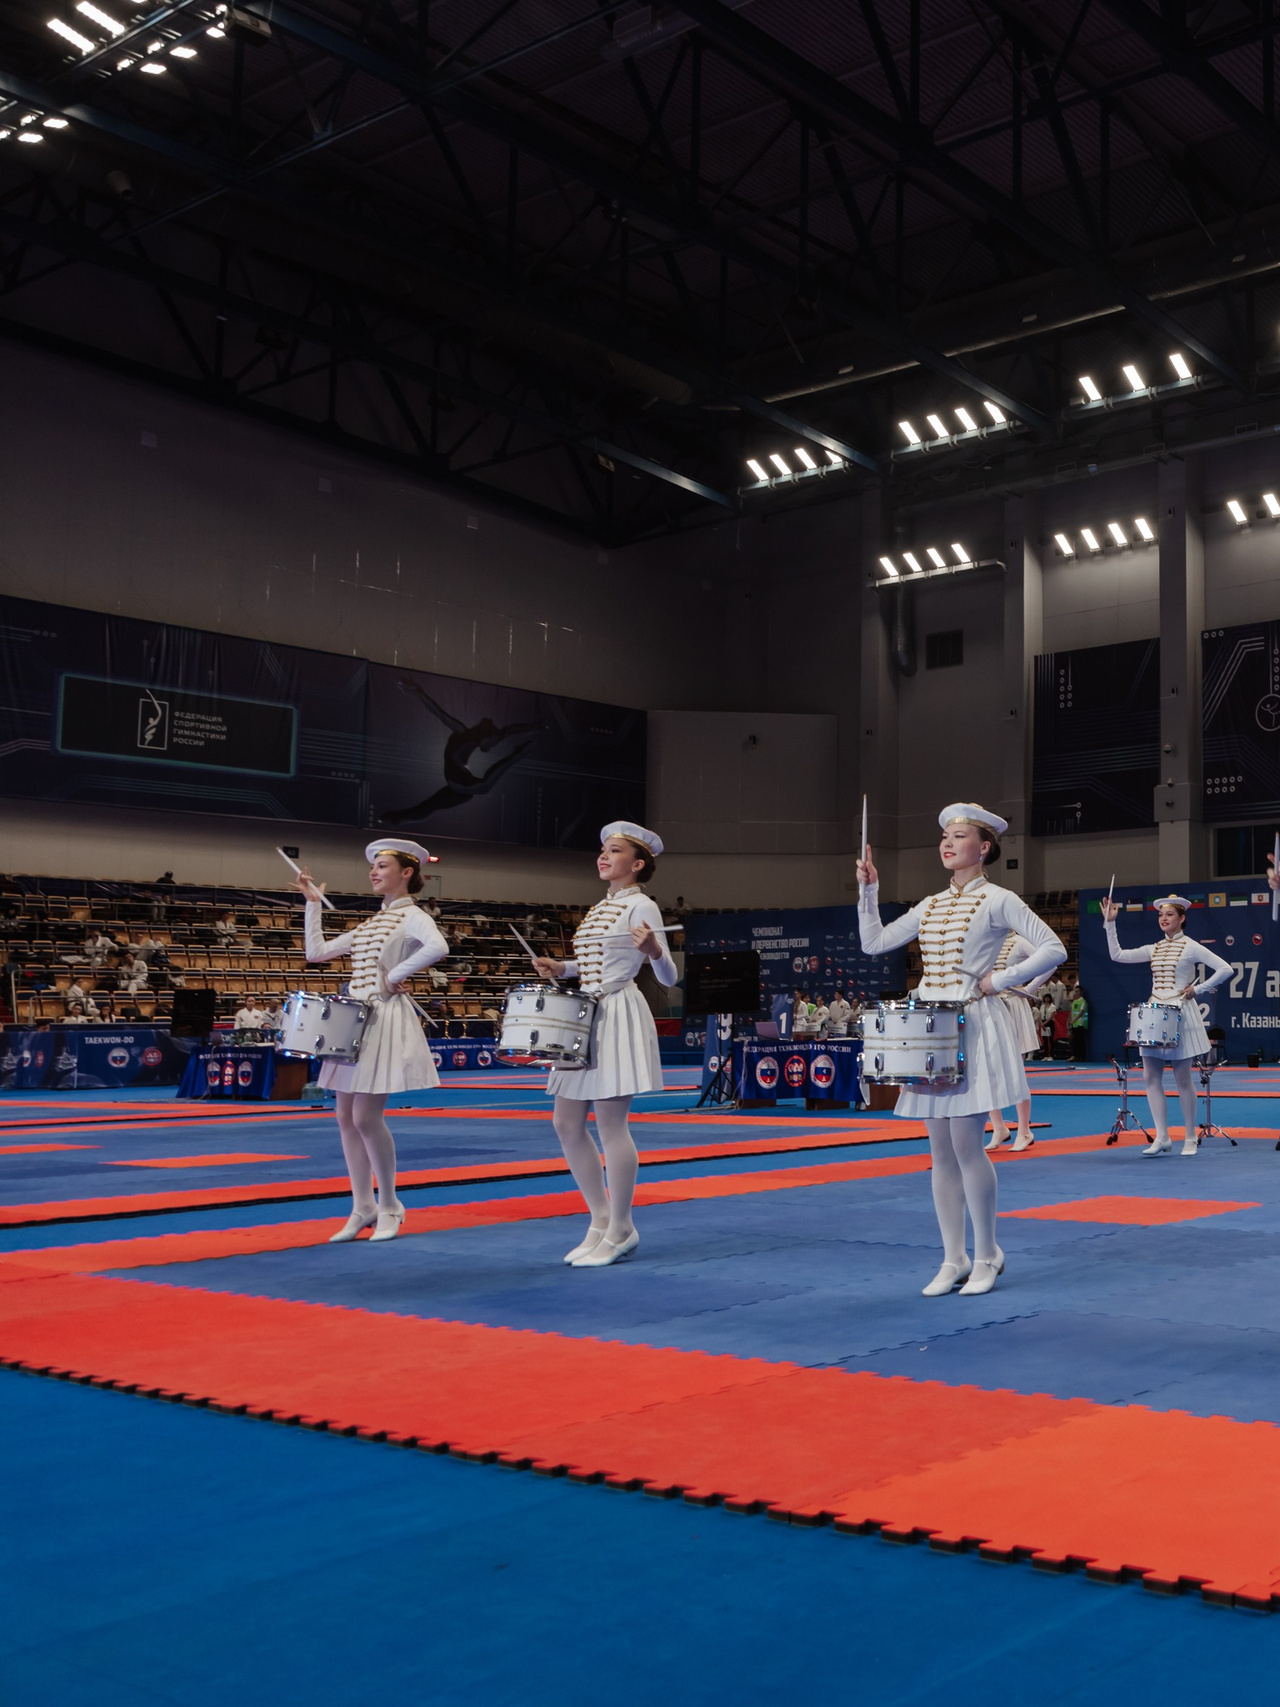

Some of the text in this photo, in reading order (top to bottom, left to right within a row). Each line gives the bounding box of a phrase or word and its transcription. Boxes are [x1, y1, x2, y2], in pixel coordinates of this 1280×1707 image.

[174, 711, 222, 723] ФЕДЕРАЦИЯ
[174, 720, 227, 732] СПОРТИВНОЙ
[173, 728, 226, 740] ГИМНАСТИКИ
[173, 737, 205, 746] РОССИИ
[789, 937, 810, 948] РОССИИ
[1230, 961, 1260, 998] 27
[1199, 1003, 1211, 1027] 2
[779, 1012, 787, 1034] 1
[1231, 1016, 1240, 1028] г.
[84, 1036, 135, 1045] TAEKWON-DO
[827, 1045, 852, 1053] РОССИИ
